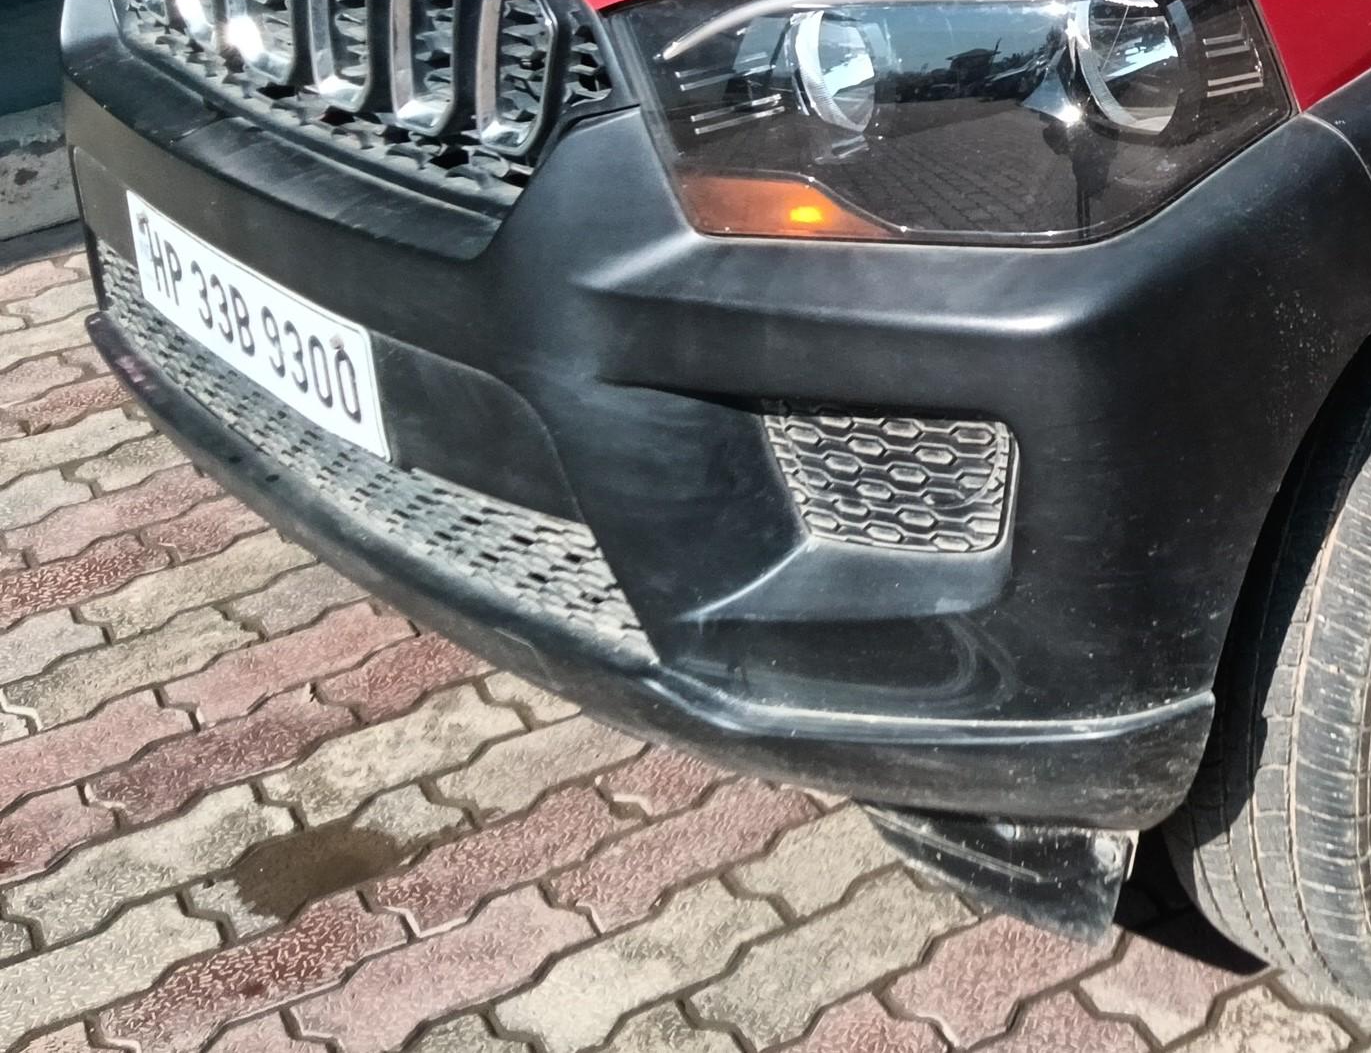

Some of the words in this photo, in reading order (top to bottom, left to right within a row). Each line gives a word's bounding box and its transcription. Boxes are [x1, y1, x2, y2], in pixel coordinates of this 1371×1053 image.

[146, 227, 183, 307] HP
[190, 259, 256, 357] 33B
[260, 305, 362, 424] 9300
